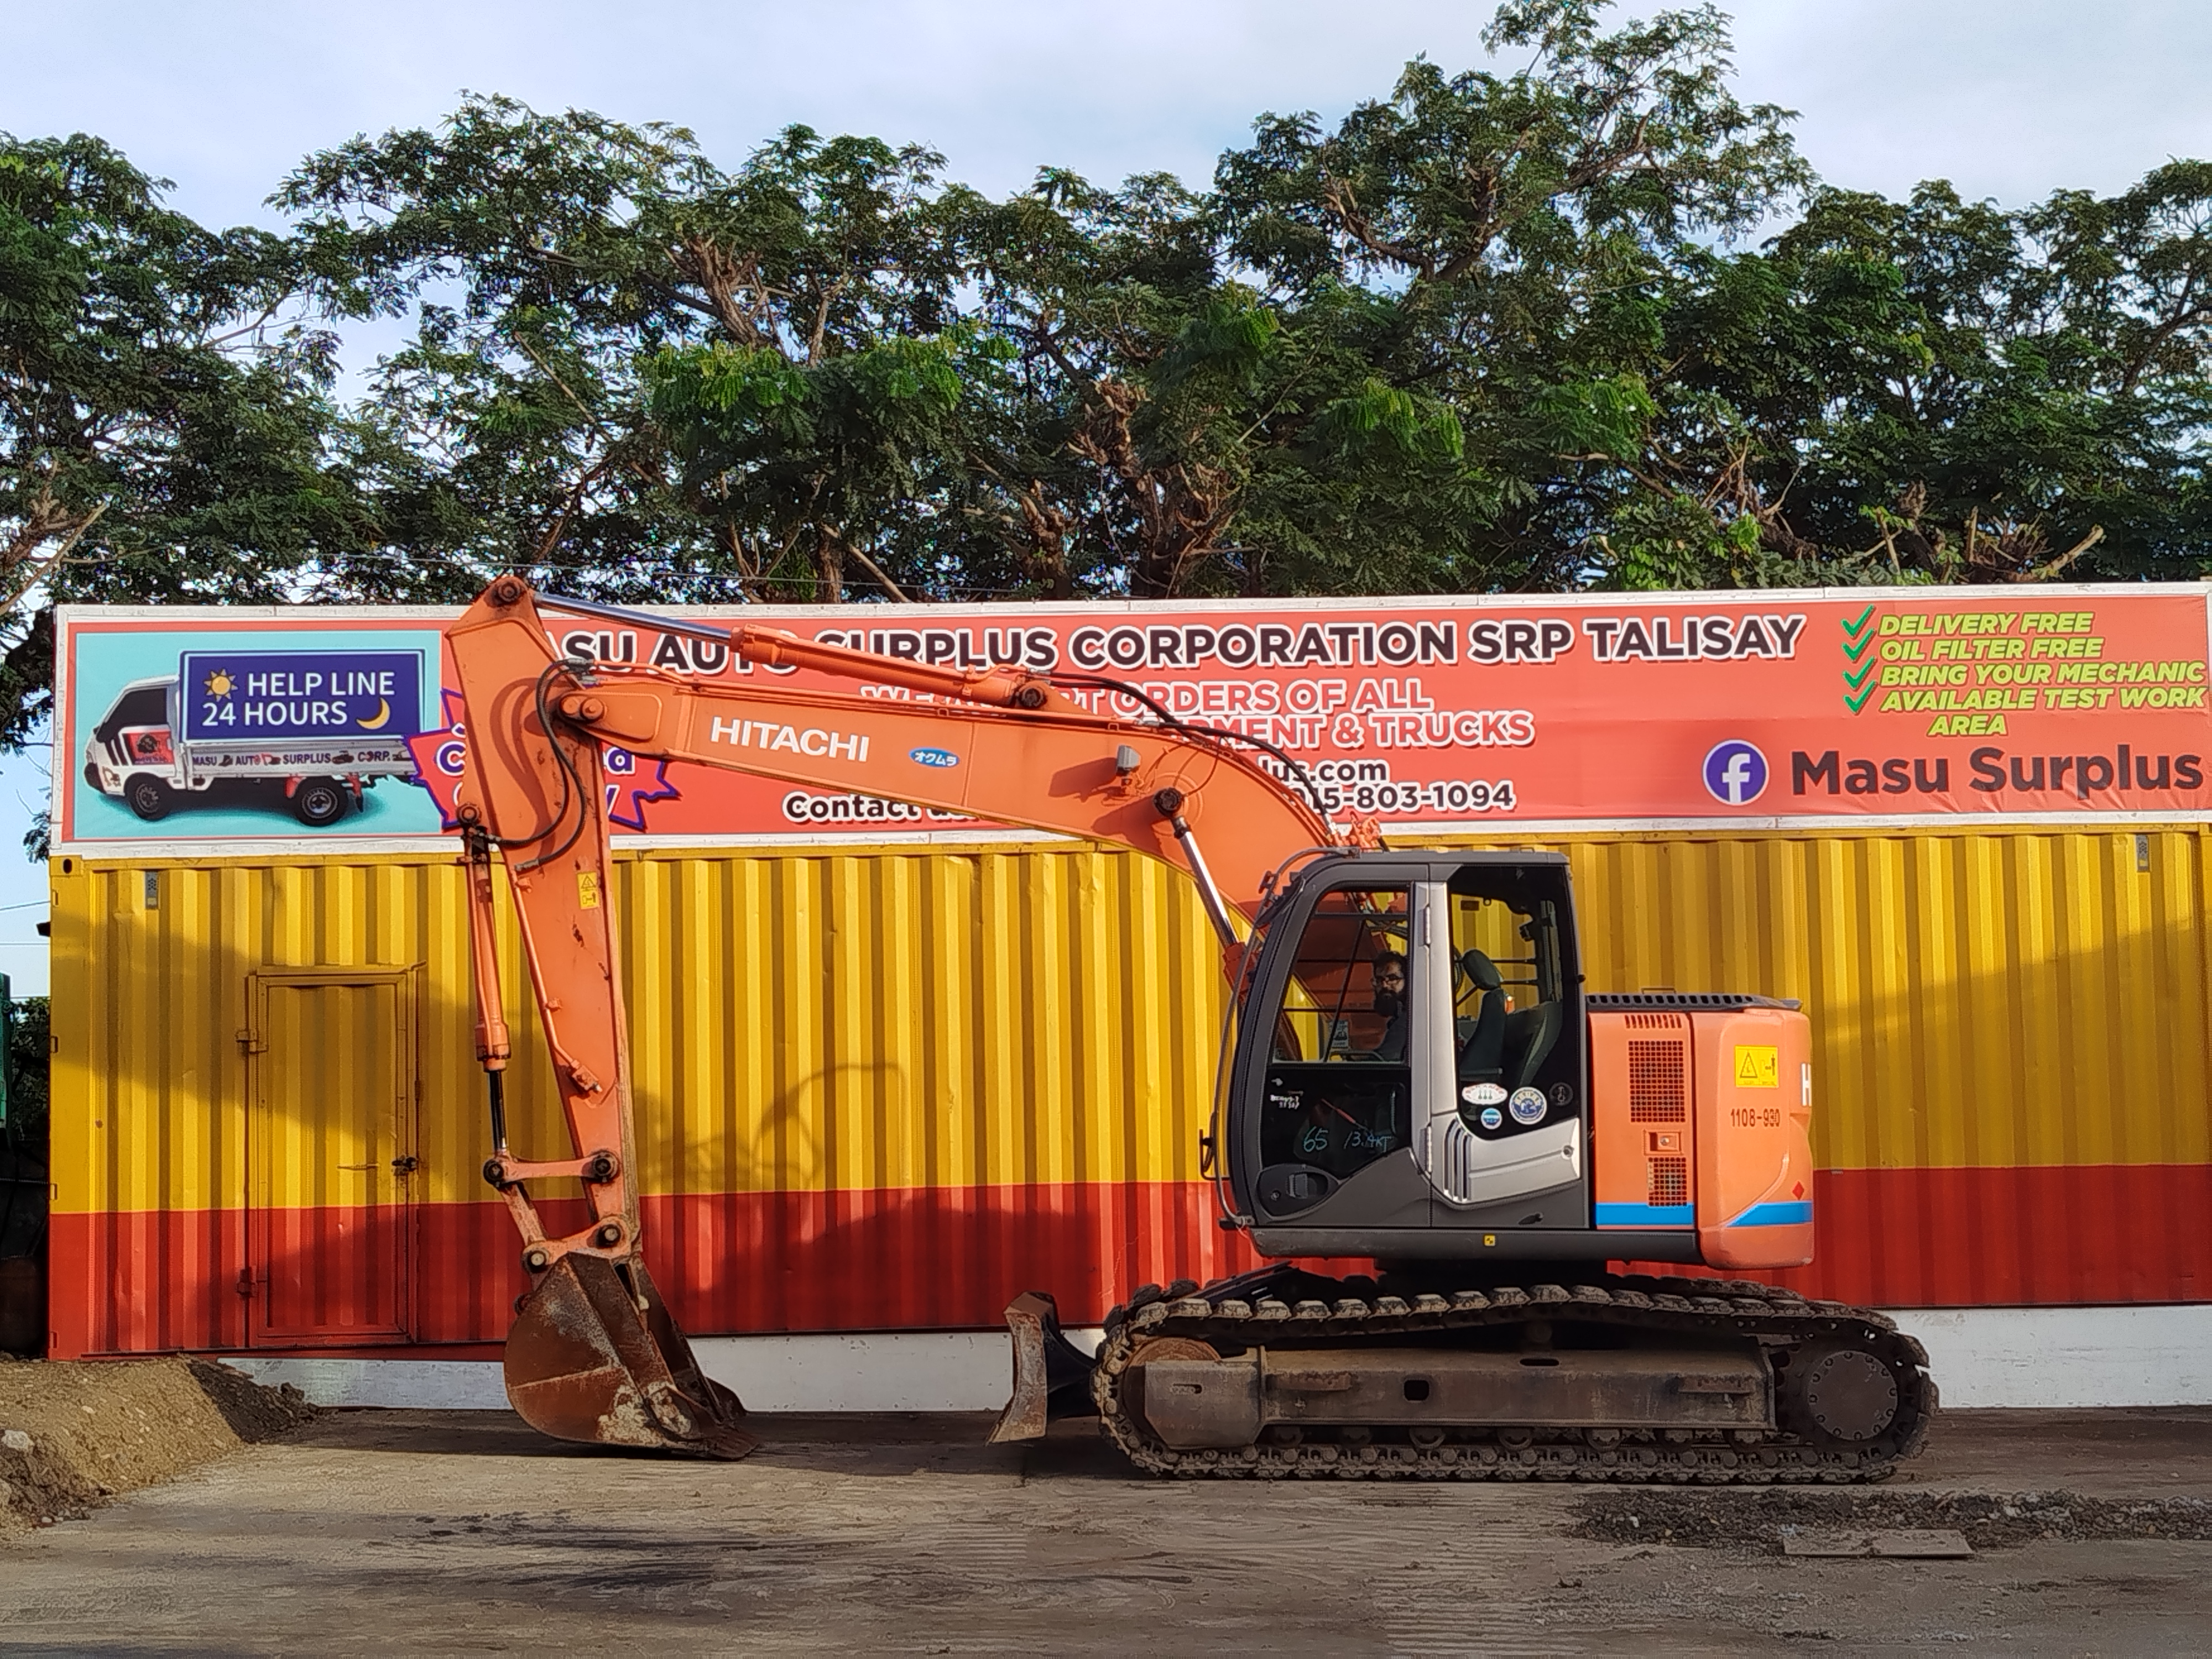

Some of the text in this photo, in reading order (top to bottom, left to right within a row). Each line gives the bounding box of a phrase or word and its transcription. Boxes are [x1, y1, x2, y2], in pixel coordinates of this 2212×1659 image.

[1879, 612, 2094, 635] DELIVERY FREE
[1072, 624, 1457, 668] CORPORATION
[1471, 620, 1572, 661] SRP
[1583, 615, 1806, 659] TALISAY
[1881, 638, 2103, 661] OIL FILTER FREE
[247, 671, 395, 697] HELP LINE
[1880, 661, 2205, 687] BRING YOUR MECHANIC
[1110, 681, 1279, 714] ORDERS
[1286, 680, 1346, 712] OF
[1352, 679, 1433, 711] ALL
[1880, 686, 2205, 711] AVAILABLE TEST WORK
[201, 701, 348, 727] 24 HOURS
[1927, 714, 2007, 736] AREA
[710, 716, 870, 763] HITACHI
[1333, 714, 1364, 745] &
[1371, 711, 1535, 744] TRUCKS
[192, 756, 217, 765] MASU
[283, 753, 332, 764] SURPLUS
[915, 750, 958, 767] オクムラ
[1791, 744, 2204, 800] Masu Surplus
[785, 795, 918, 818] Contact
[1303, 1126, 1328, 1152] 65
